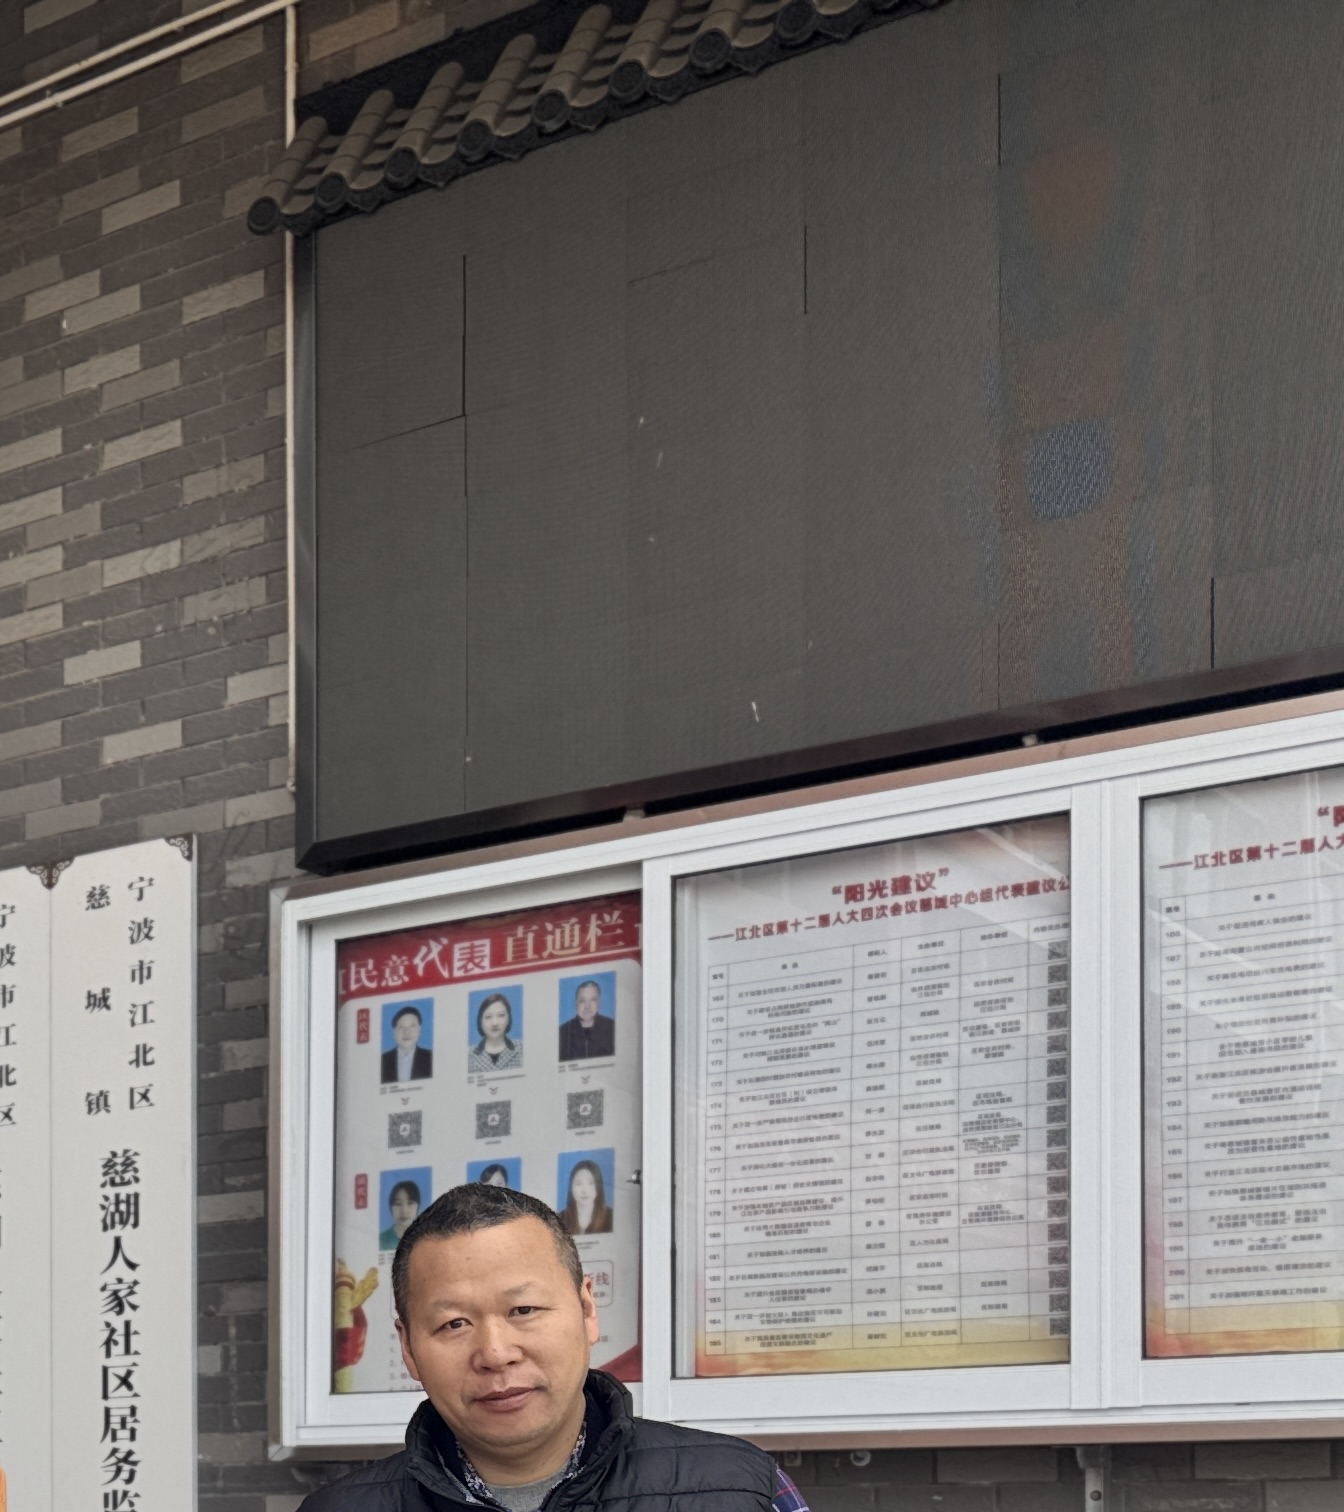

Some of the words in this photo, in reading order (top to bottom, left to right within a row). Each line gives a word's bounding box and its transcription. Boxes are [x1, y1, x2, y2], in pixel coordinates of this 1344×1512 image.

[83, 883, 113, 1117] 慈城镇
[127, 876, 157, 1111] 宁波市江北区
[832, 868, 950, 905] “阳光建议”
